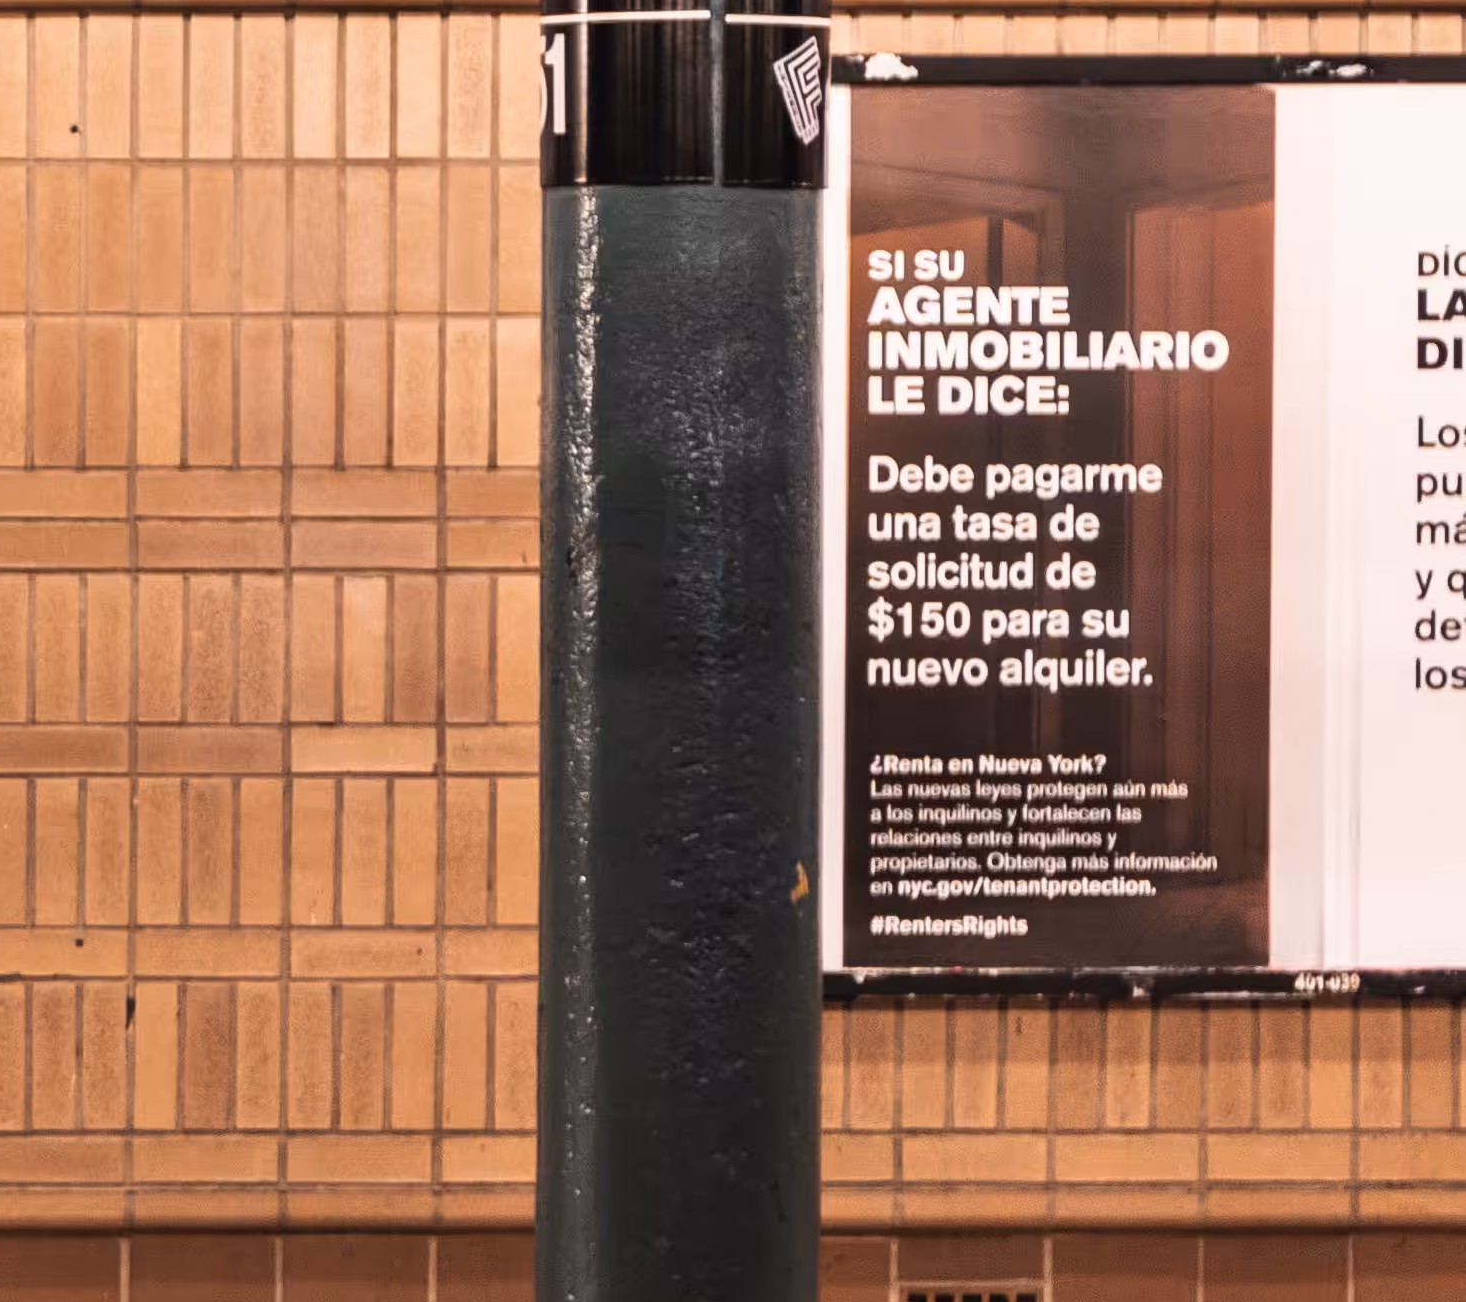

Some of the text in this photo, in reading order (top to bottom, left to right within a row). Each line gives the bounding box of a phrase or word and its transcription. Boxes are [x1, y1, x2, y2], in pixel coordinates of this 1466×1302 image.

[868, 250, 964, 281] SI SU
[867, 285, 1070, 326] AGENTE
[1417, 288, 1466, 321] LA
[868, 330, 1229, 371] INMOBILIARIO
[868, 375, 1070, 416] LE DICE:
[1418, 416, 1466, 448] Lo
[868, 455, 1163, 499] Debe pagarme
[868, 504, 1100, 541] una tasa de
[868, 552, 1096, 589] solicitud de
[1415, 569, 1433, 601] y
[868, 596, 1129, 644] $150 para su
[1415, 609, 1466, 641] de
[868, 649, 1153, 693] nuevo alquiler.
[1415, 657, 1466, 690] los
[870, 754, 1106, 775] ¿Renta en Nueva York?
[870, 780, 1189, 803] Las nuevas leyes protegen aún más
[870, 804, 1142, 827] a los inquilinos y fortalecen las
[870, 829, 1117, 851] relaciones entre inquilinos y
[870, 852, 1218, 875] propietarios. Obtenga más información
[870, 877, 1157, 900] en nyc.gov/tenantprotection.
[870, 916, 1028, 939] #RentersRights
